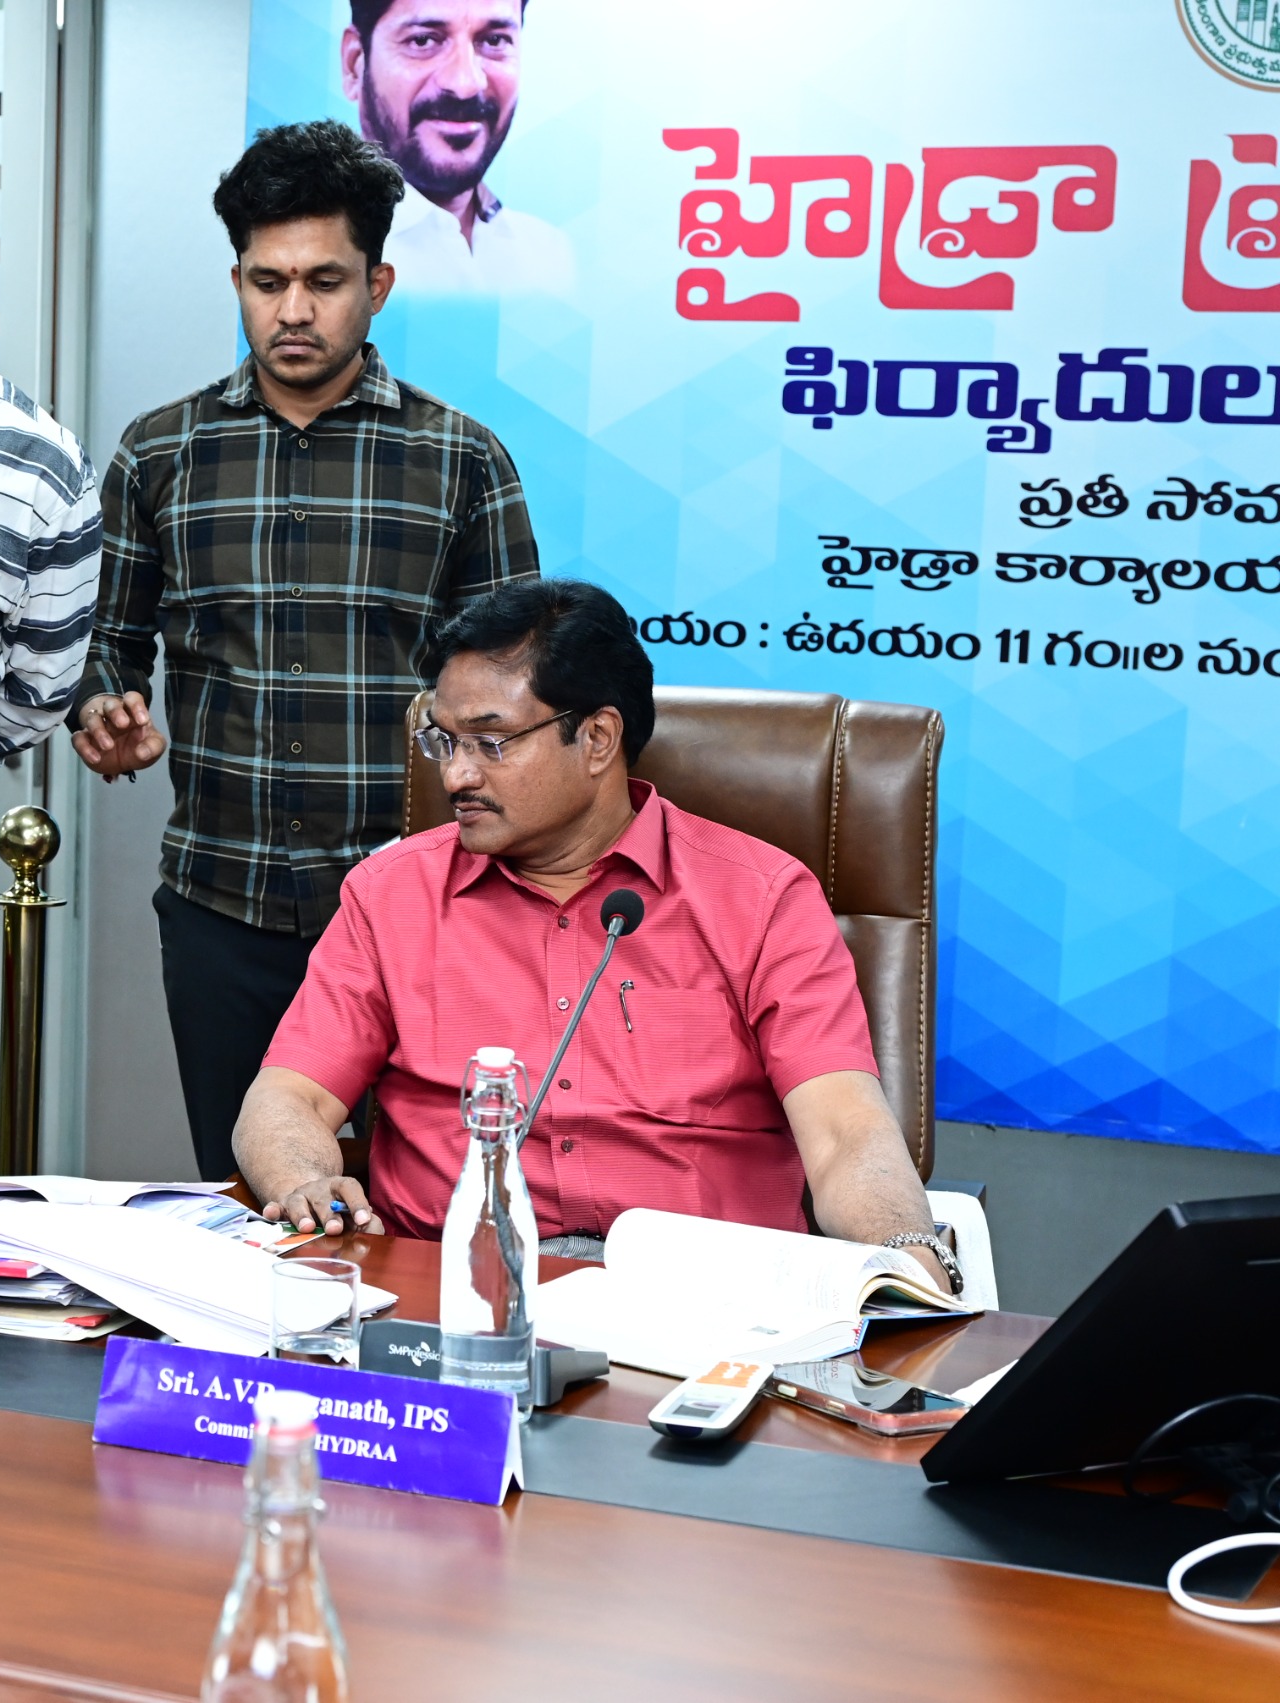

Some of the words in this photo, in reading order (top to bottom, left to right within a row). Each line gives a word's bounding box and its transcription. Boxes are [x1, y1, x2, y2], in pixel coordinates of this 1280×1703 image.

[662, 127, 1117, 322] హైడ్రా
[1019, 473, 1130, 529] ప్రతీ
[817, 535, 979, 592] హైడ్రా
[782, 611, 982, 661] ఉదయం
[995, 628, 1030, 664] 11
[157, 1368, 200, 1396] Sri.
[204, 1376, 396, 1430] A.V.anath,
[402, 1402, 450, 1433] IPS
[314, 1433, 398, 1463] HYDRAA
